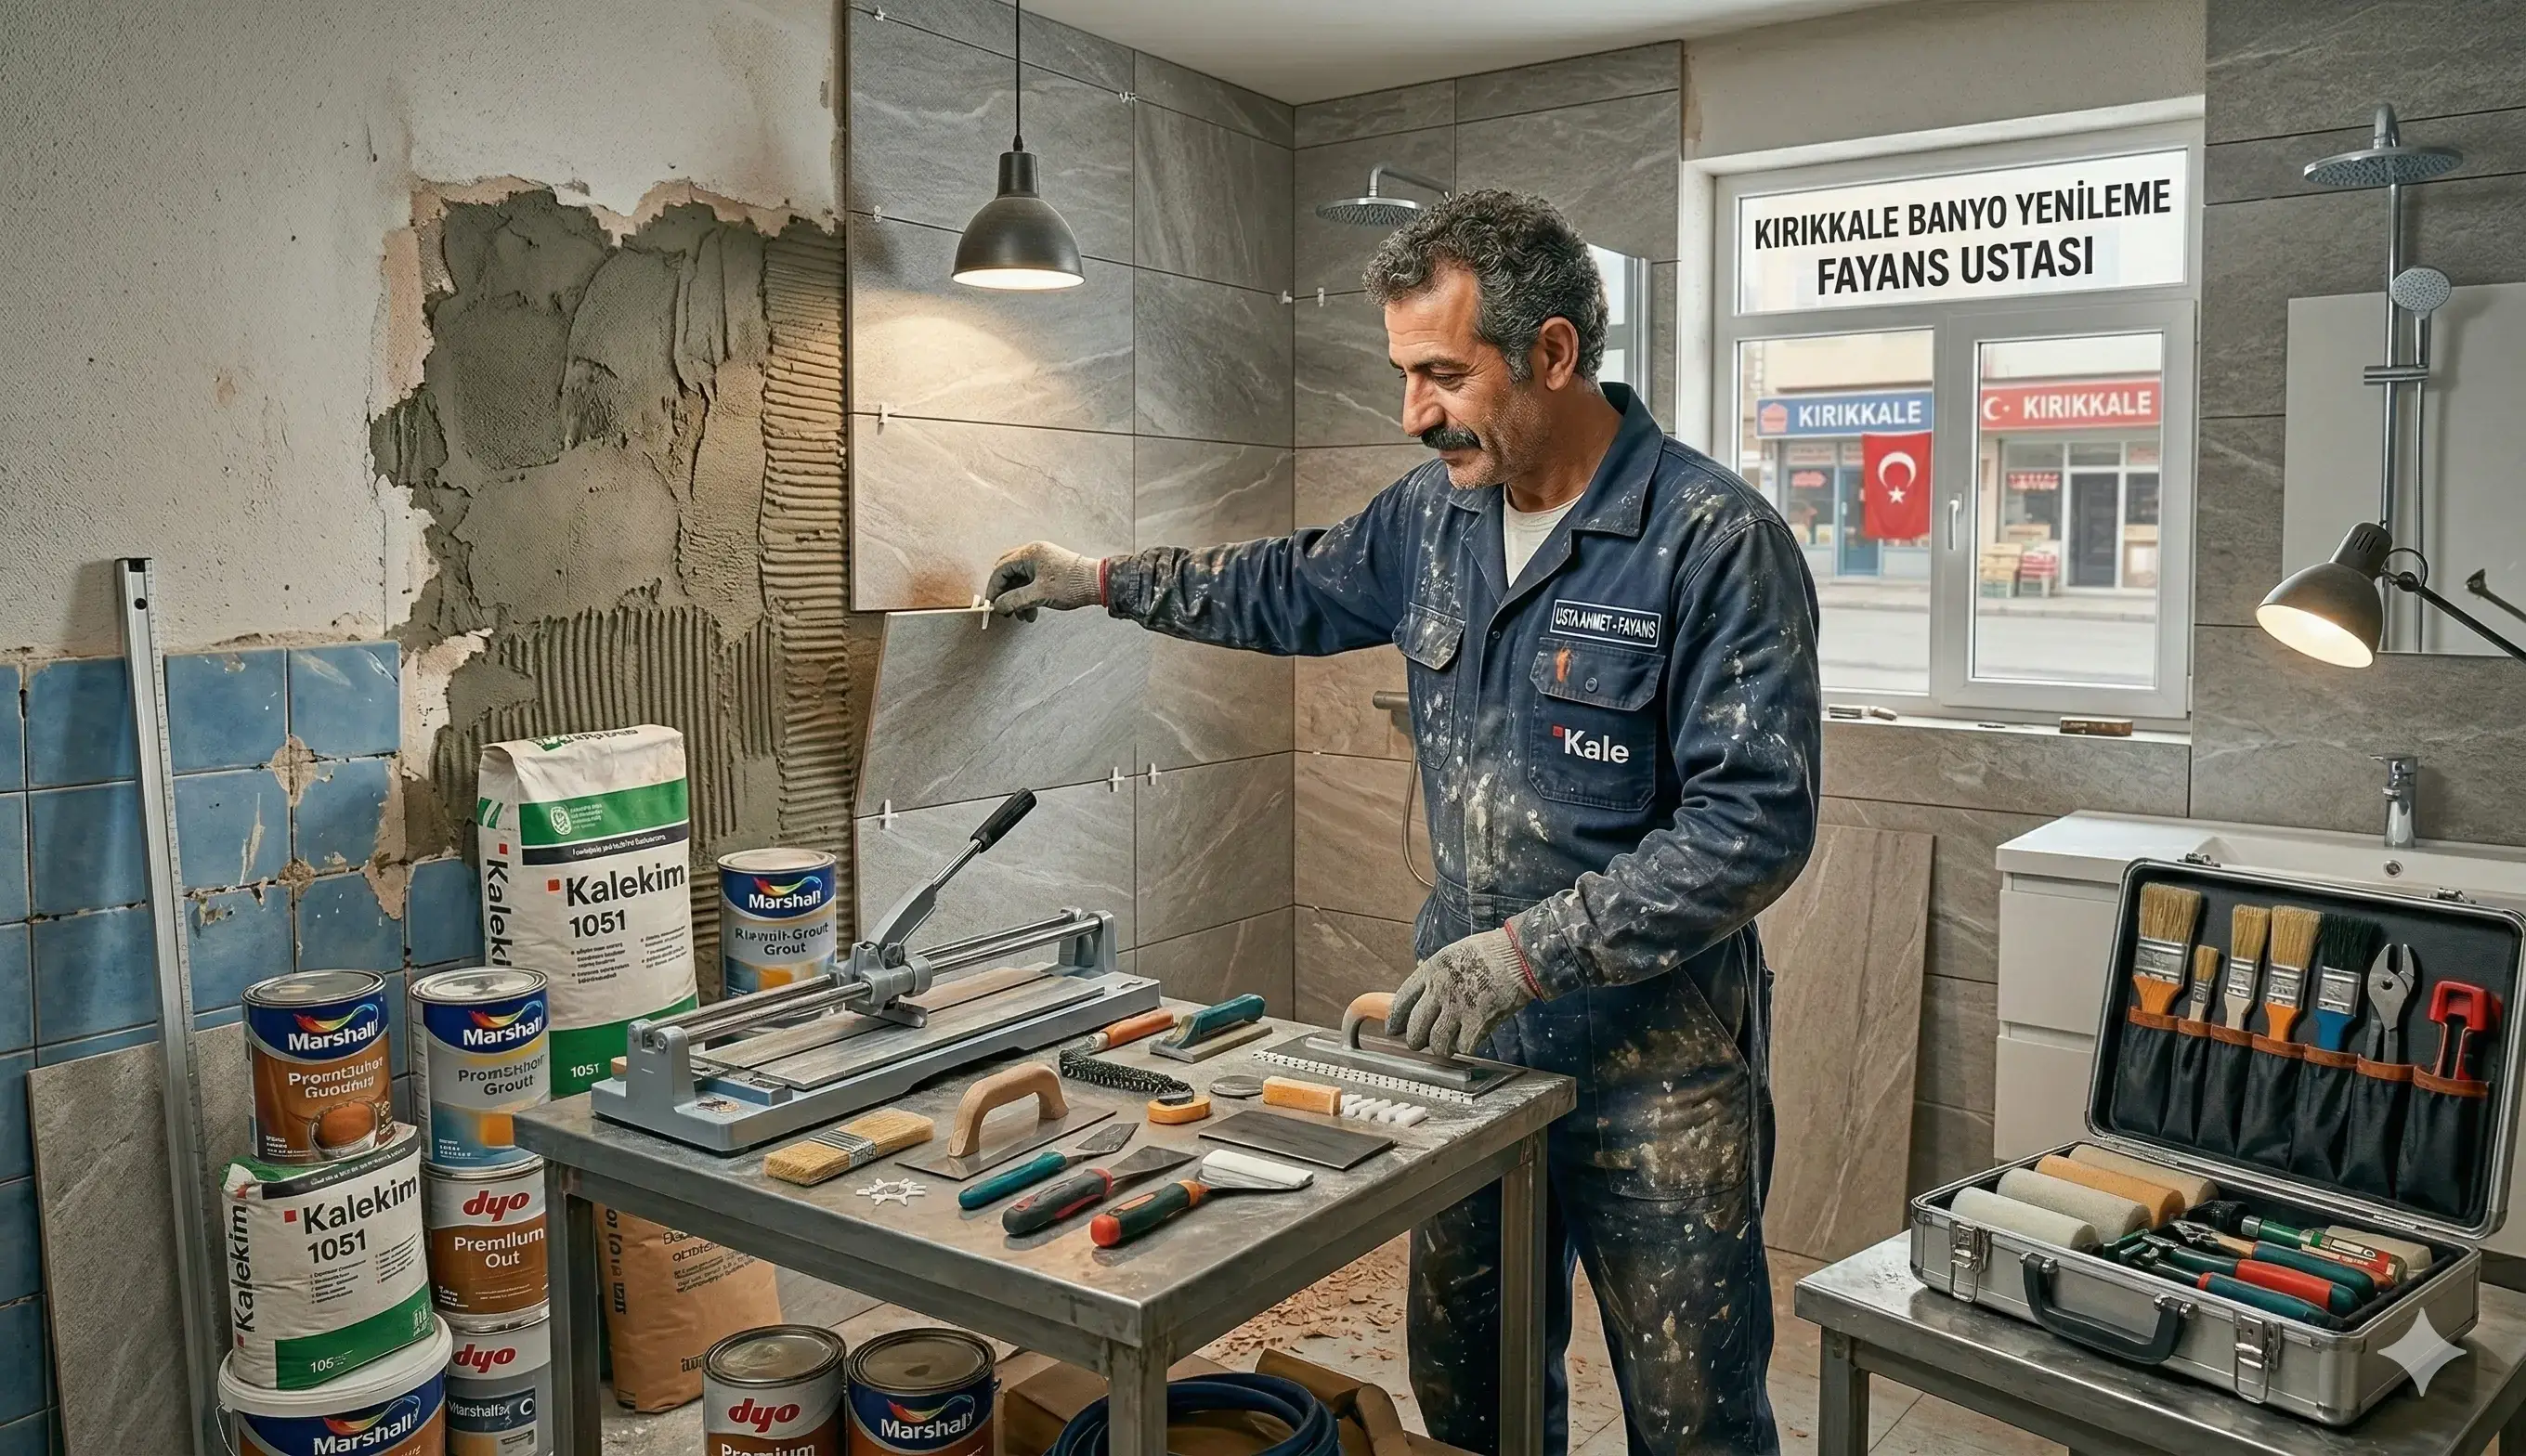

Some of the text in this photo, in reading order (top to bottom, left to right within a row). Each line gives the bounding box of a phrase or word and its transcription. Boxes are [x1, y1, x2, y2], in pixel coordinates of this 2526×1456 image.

[1755, 178, 2170, 249] KIRIKKALE BANYO YENİLEME
[1817, 236, 2092, 295] FAYANS USTASI
[1799, 400, 1921, 428] KIRIKKALE
[2023, 390, 2152, 420] KIRIKKALE
[1618, 616, 1656, 639] FAYANS
[1564, 728, 1630, 764] Kale
[566, 862, 685, 907] Kalekim
[486, 858, 513, 966] Kaleki
[568, 909, 627, 938] 1051
[763, 943, 807, 956] Grout
[303, 1175, 417, 1235] Kalekim
[462, 1190, 530, 1223] dyo
[307, 1228, 367, 1264] 1051
[485, 1251, 520, 1268] Out
[228, 1205, 255, 1333] Kalekim
[451, 1343, 516, 1374] dyo
[727, 1397, 801, 1433] dyo
